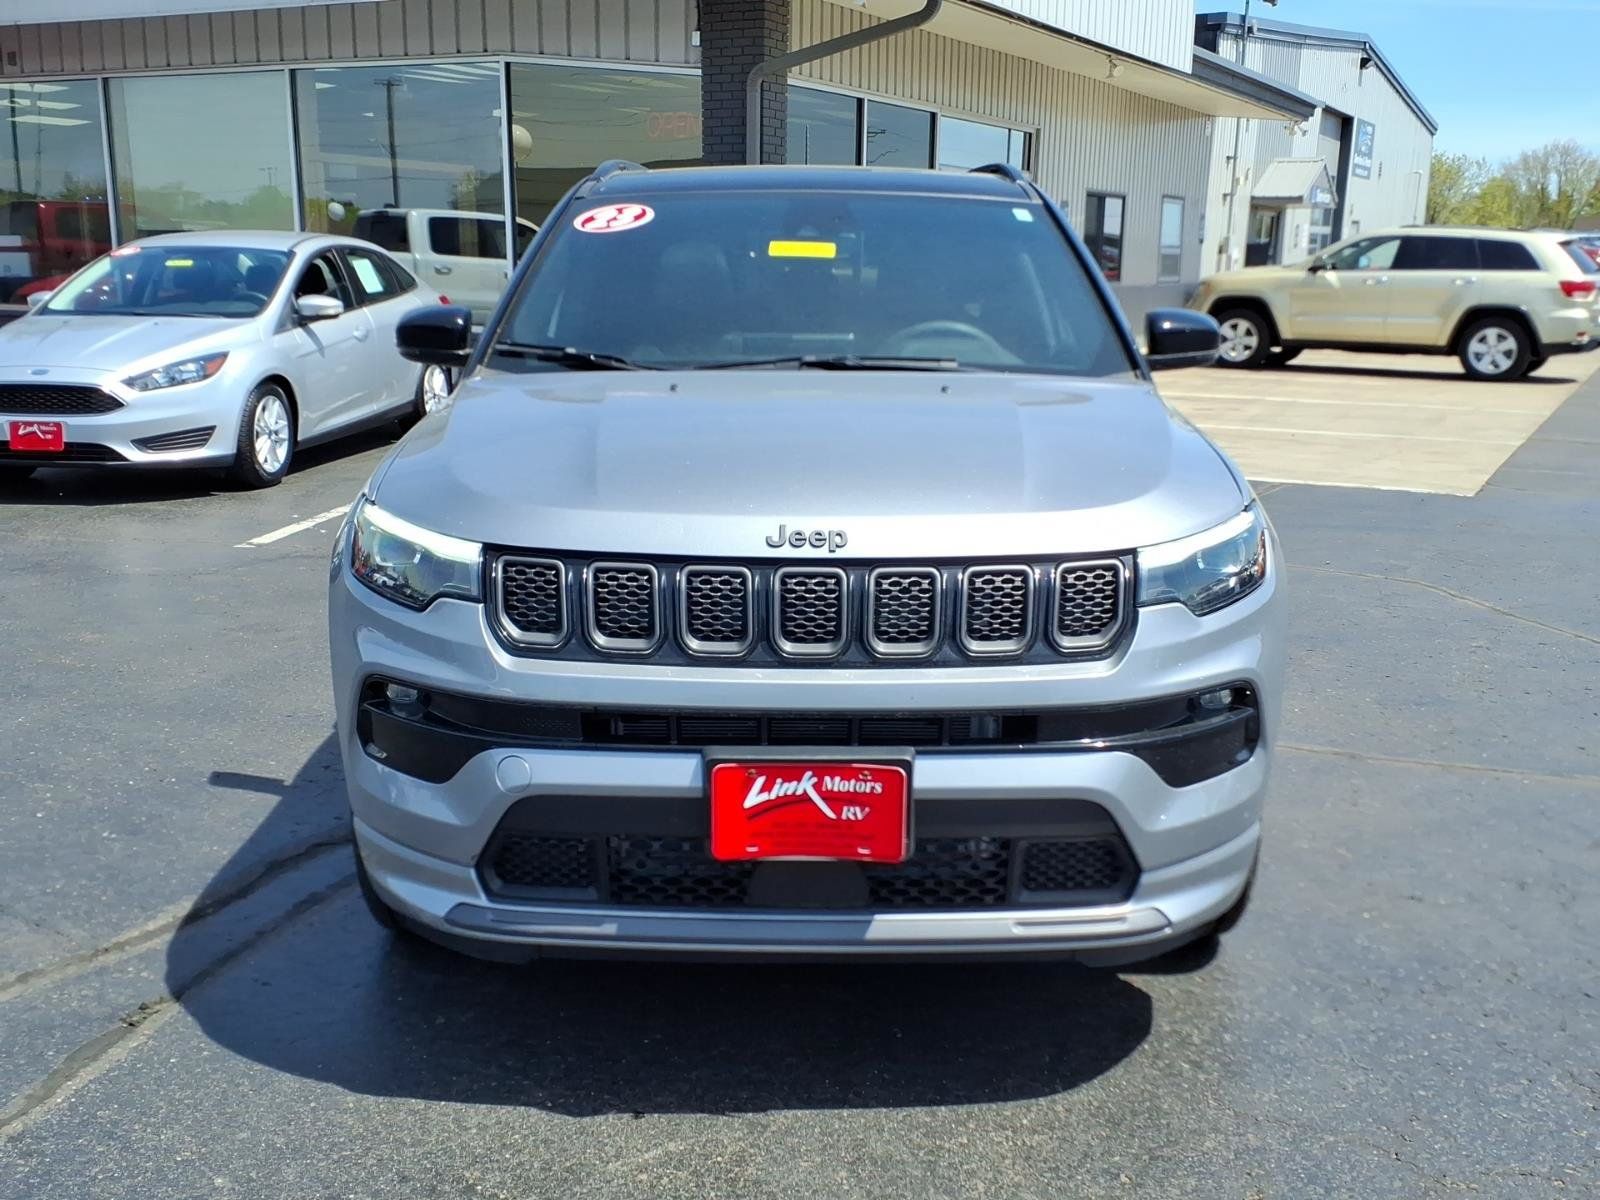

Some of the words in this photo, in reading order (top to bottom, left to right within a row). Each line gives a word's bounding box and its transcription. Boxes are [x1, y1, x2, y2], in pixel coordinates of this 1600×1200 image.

[766, 523, 848, 552] Jeep
[743, 771, 836, 819] Link
[822, 775, 882, 795] Motors
[840, 806, 870, 821] RV
